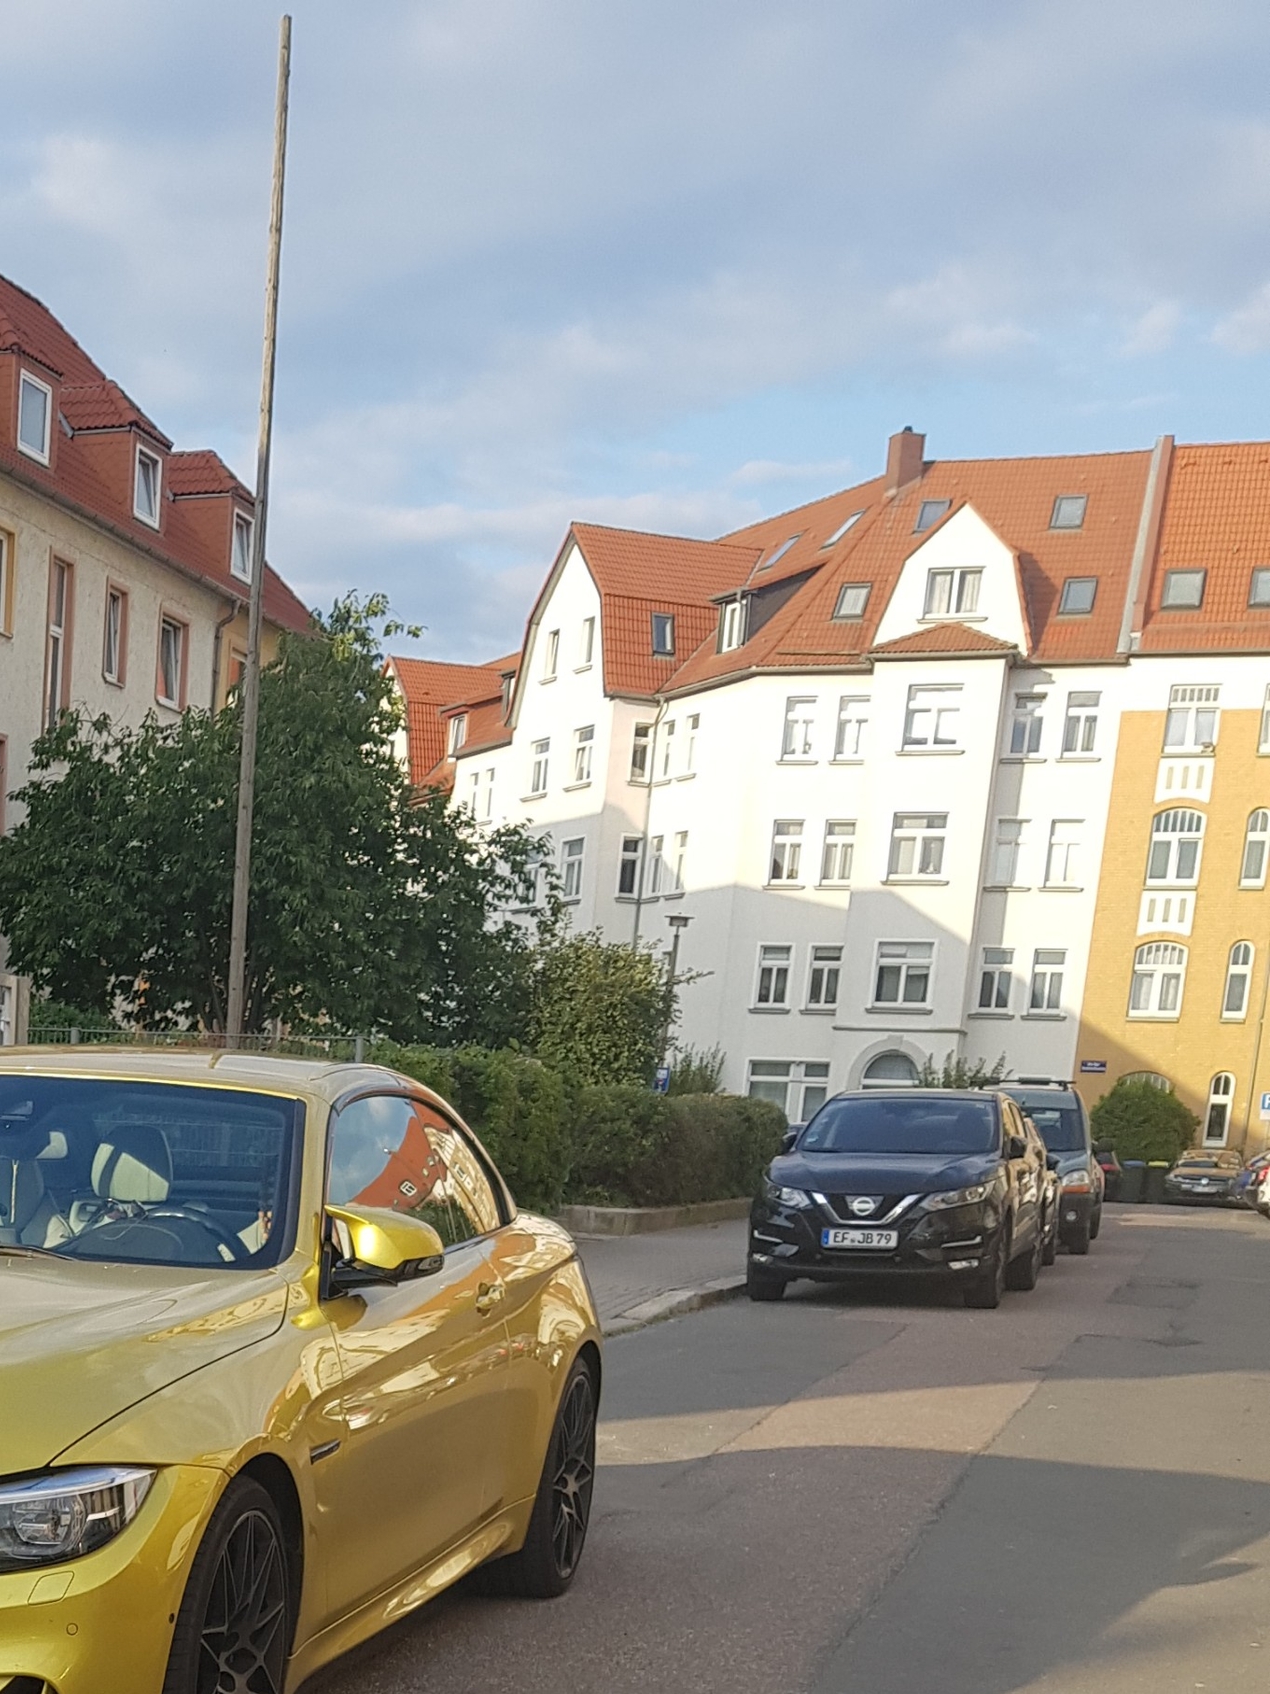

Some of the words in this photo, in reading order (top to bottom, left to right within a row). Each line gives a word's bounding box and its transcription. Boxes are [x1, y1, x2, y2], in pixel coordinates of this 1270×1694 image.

[833, 1231, 850, 1243] EF
[857, 1232, 874, 1244] JB
[876, 1233, 892, 1244] 79
